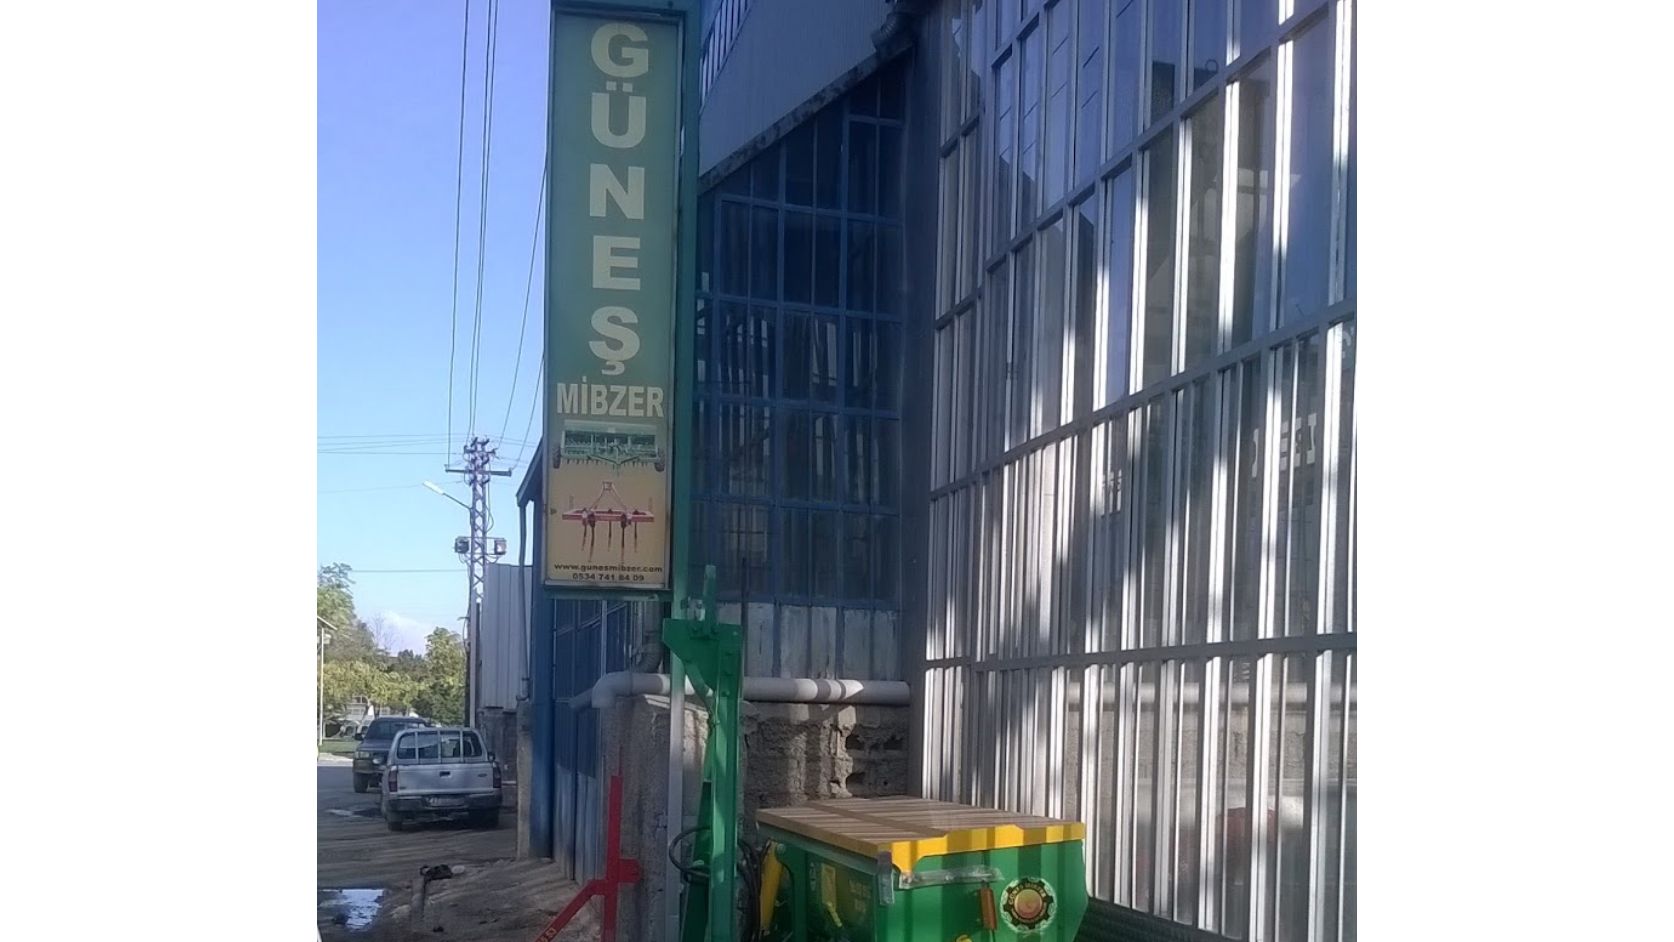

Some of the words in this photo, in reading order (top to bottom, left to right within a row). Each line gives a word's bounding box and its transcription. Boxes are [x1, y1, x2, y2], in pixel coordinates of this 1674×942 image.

[589, 22, 649, 376] GÜNEŞ
[557, 376, 664, 417] MİBZER
[572, 573, 596, 581] 0534
[599, 573, 615, 581] 741
